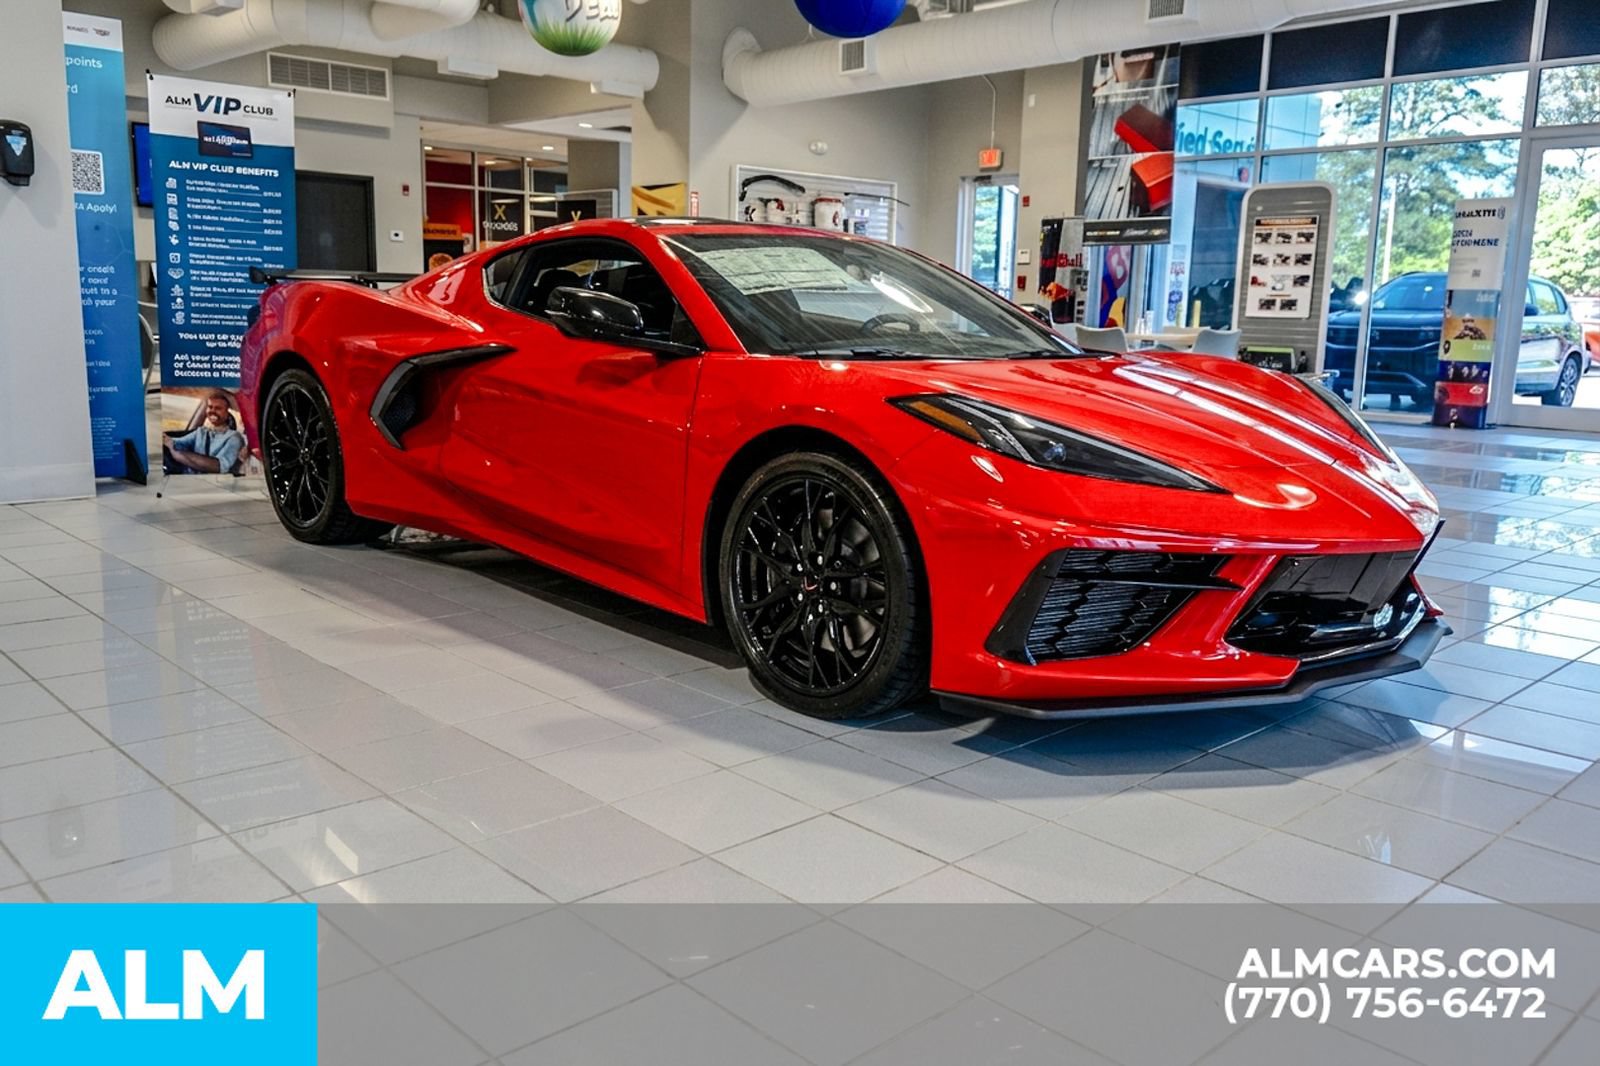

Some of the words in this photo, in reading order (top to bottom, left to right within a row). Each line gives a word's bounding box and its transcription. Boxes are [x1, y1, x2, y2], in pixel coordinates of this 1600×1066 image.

[65, 56, 103, 68] points
[165, 95, 191, 106] ALM
[193, 93, 242, 115] VIP
[243, 104, 273, 116] CLUB
[168, 160, 190, 170] ALM
[192, 162, 208, 171] VIP
[210, 163, 234, 173] CLUB
[236, 166, 279, 177] BENEFITS
